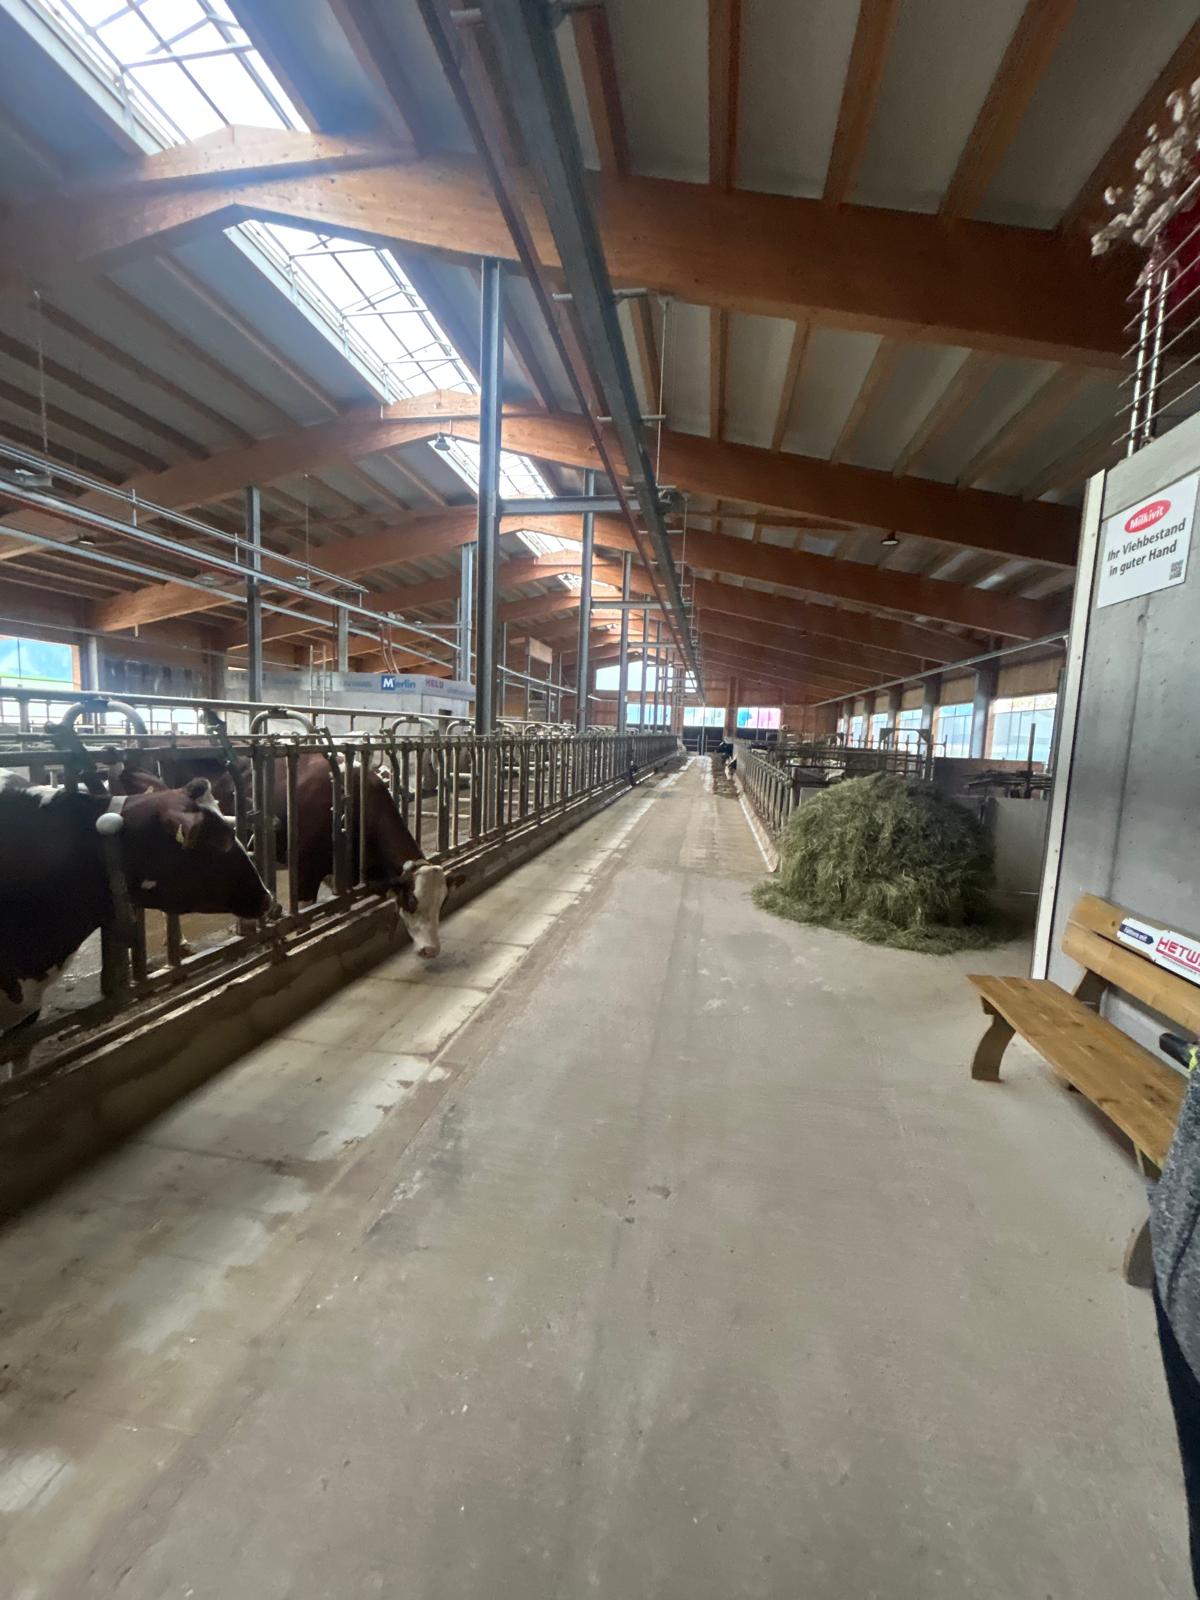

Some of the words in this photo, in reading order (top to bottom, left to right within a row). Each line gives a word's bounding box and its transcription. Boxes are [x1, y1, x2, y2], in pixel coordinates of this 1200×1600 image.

[1107, 549, 1120, 561] Ihr
[1123, 517, 1186, 555] Viehbestand
[1109, 565, 1118, 576] in
[1120, 555, 1146, 575] guter
[1149, 539, 1177, 561] Hand
[383, 678, 416, 689] Merlin
[1157, 937, 1200, 967] HETW
